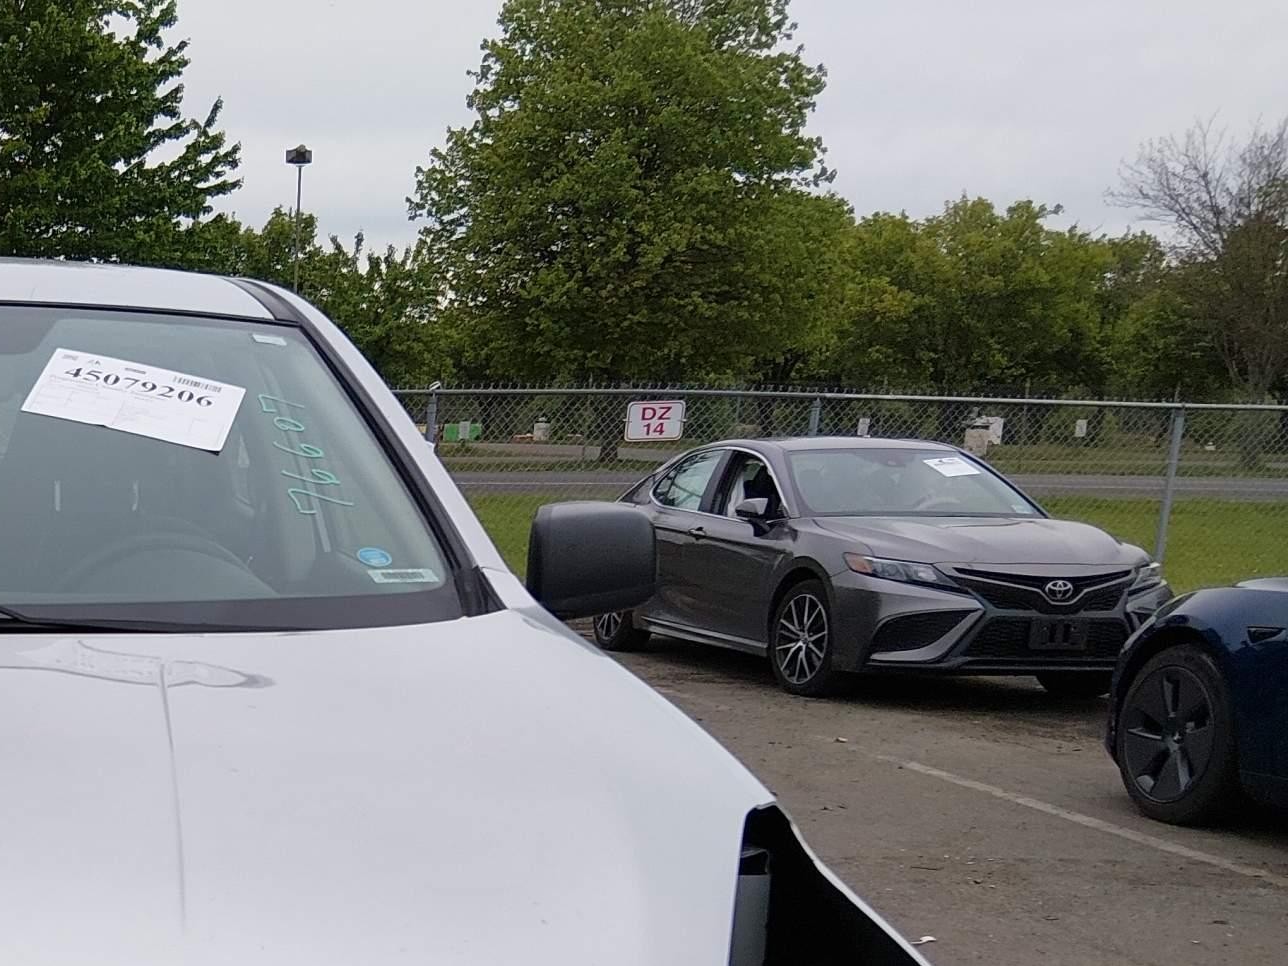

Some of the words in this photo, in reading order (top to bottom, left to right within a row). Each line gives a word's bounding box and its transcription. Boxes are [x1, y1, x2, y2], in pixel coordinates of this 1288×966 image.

[64, 367, 213, 408] 45079206
[641, 406, 673, 421] DZ
[643, 422, 665, 436] 14
[258, 394, 354, 514] 76607
